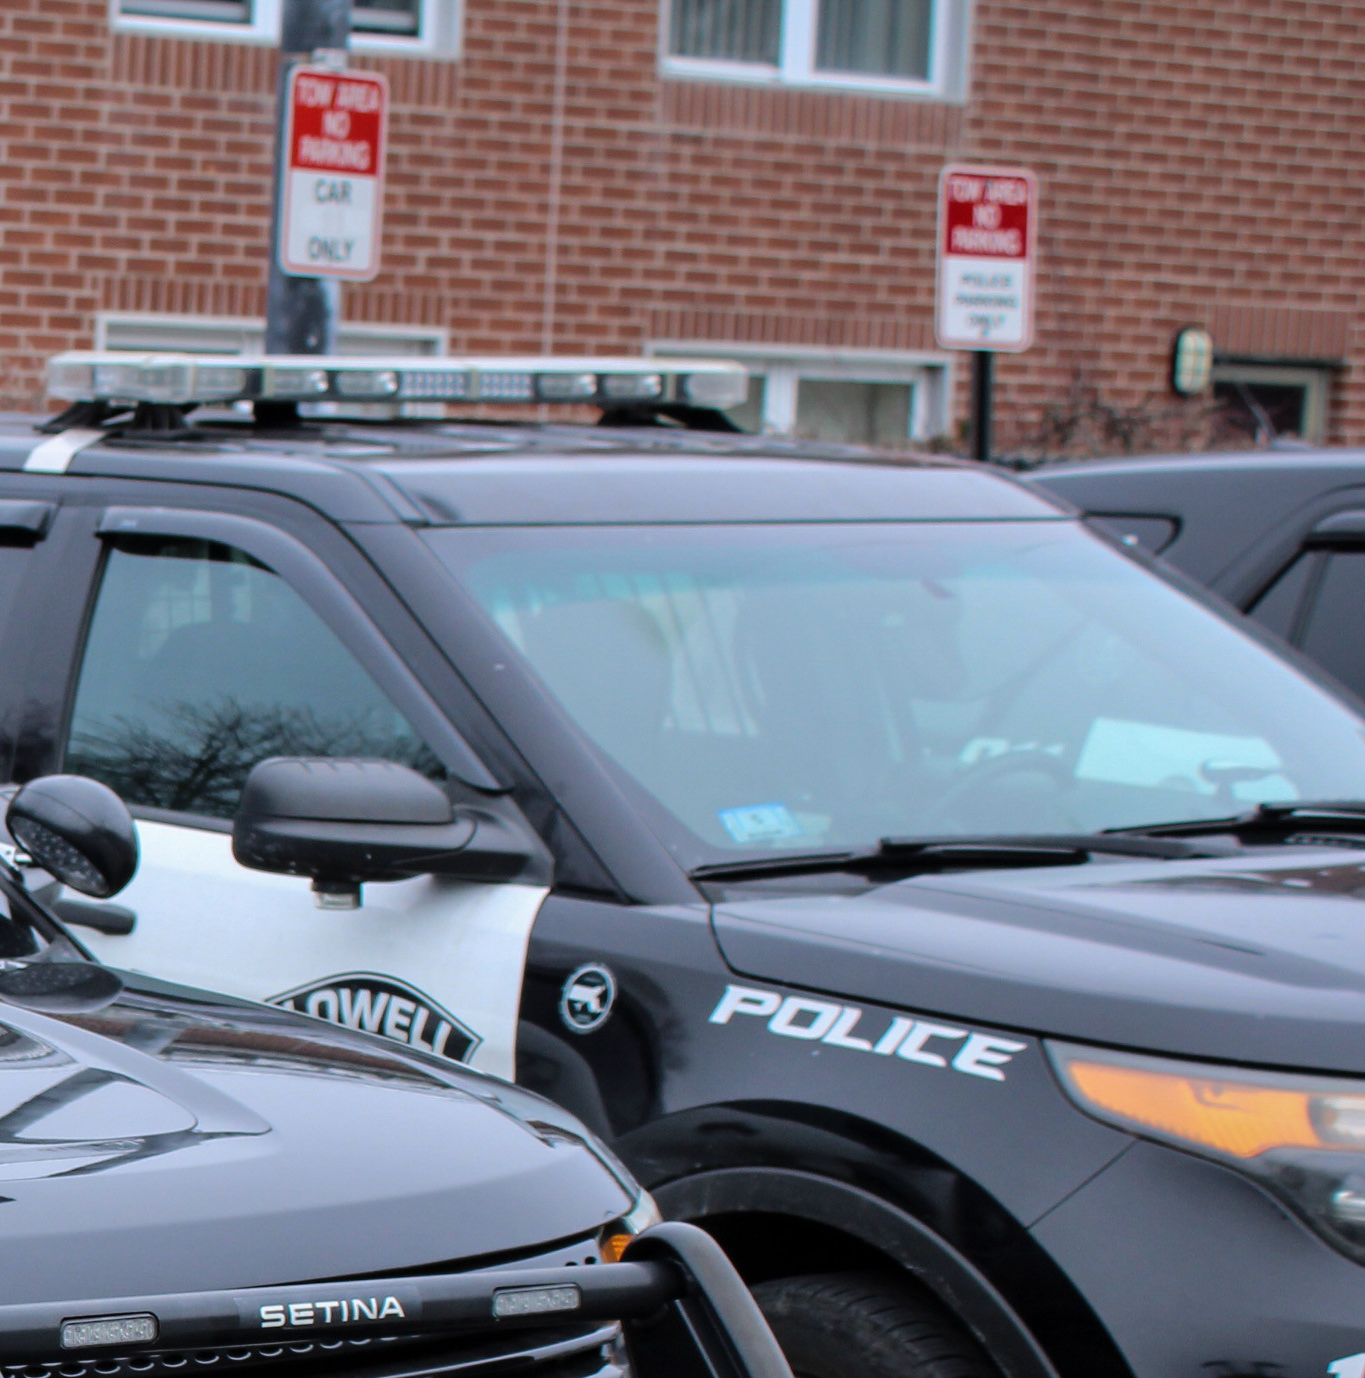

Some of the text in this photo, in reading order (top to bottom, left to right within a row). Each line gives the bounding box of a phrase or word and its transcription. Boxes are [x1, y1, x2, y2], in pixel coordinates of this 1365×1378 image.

[315, 178, 353, 203] CAR
[307, 235, 355, 262] ONLY
[708, 984, 1028, 1081] POLICE
[260, 1296, 405, 1328] SETINA
